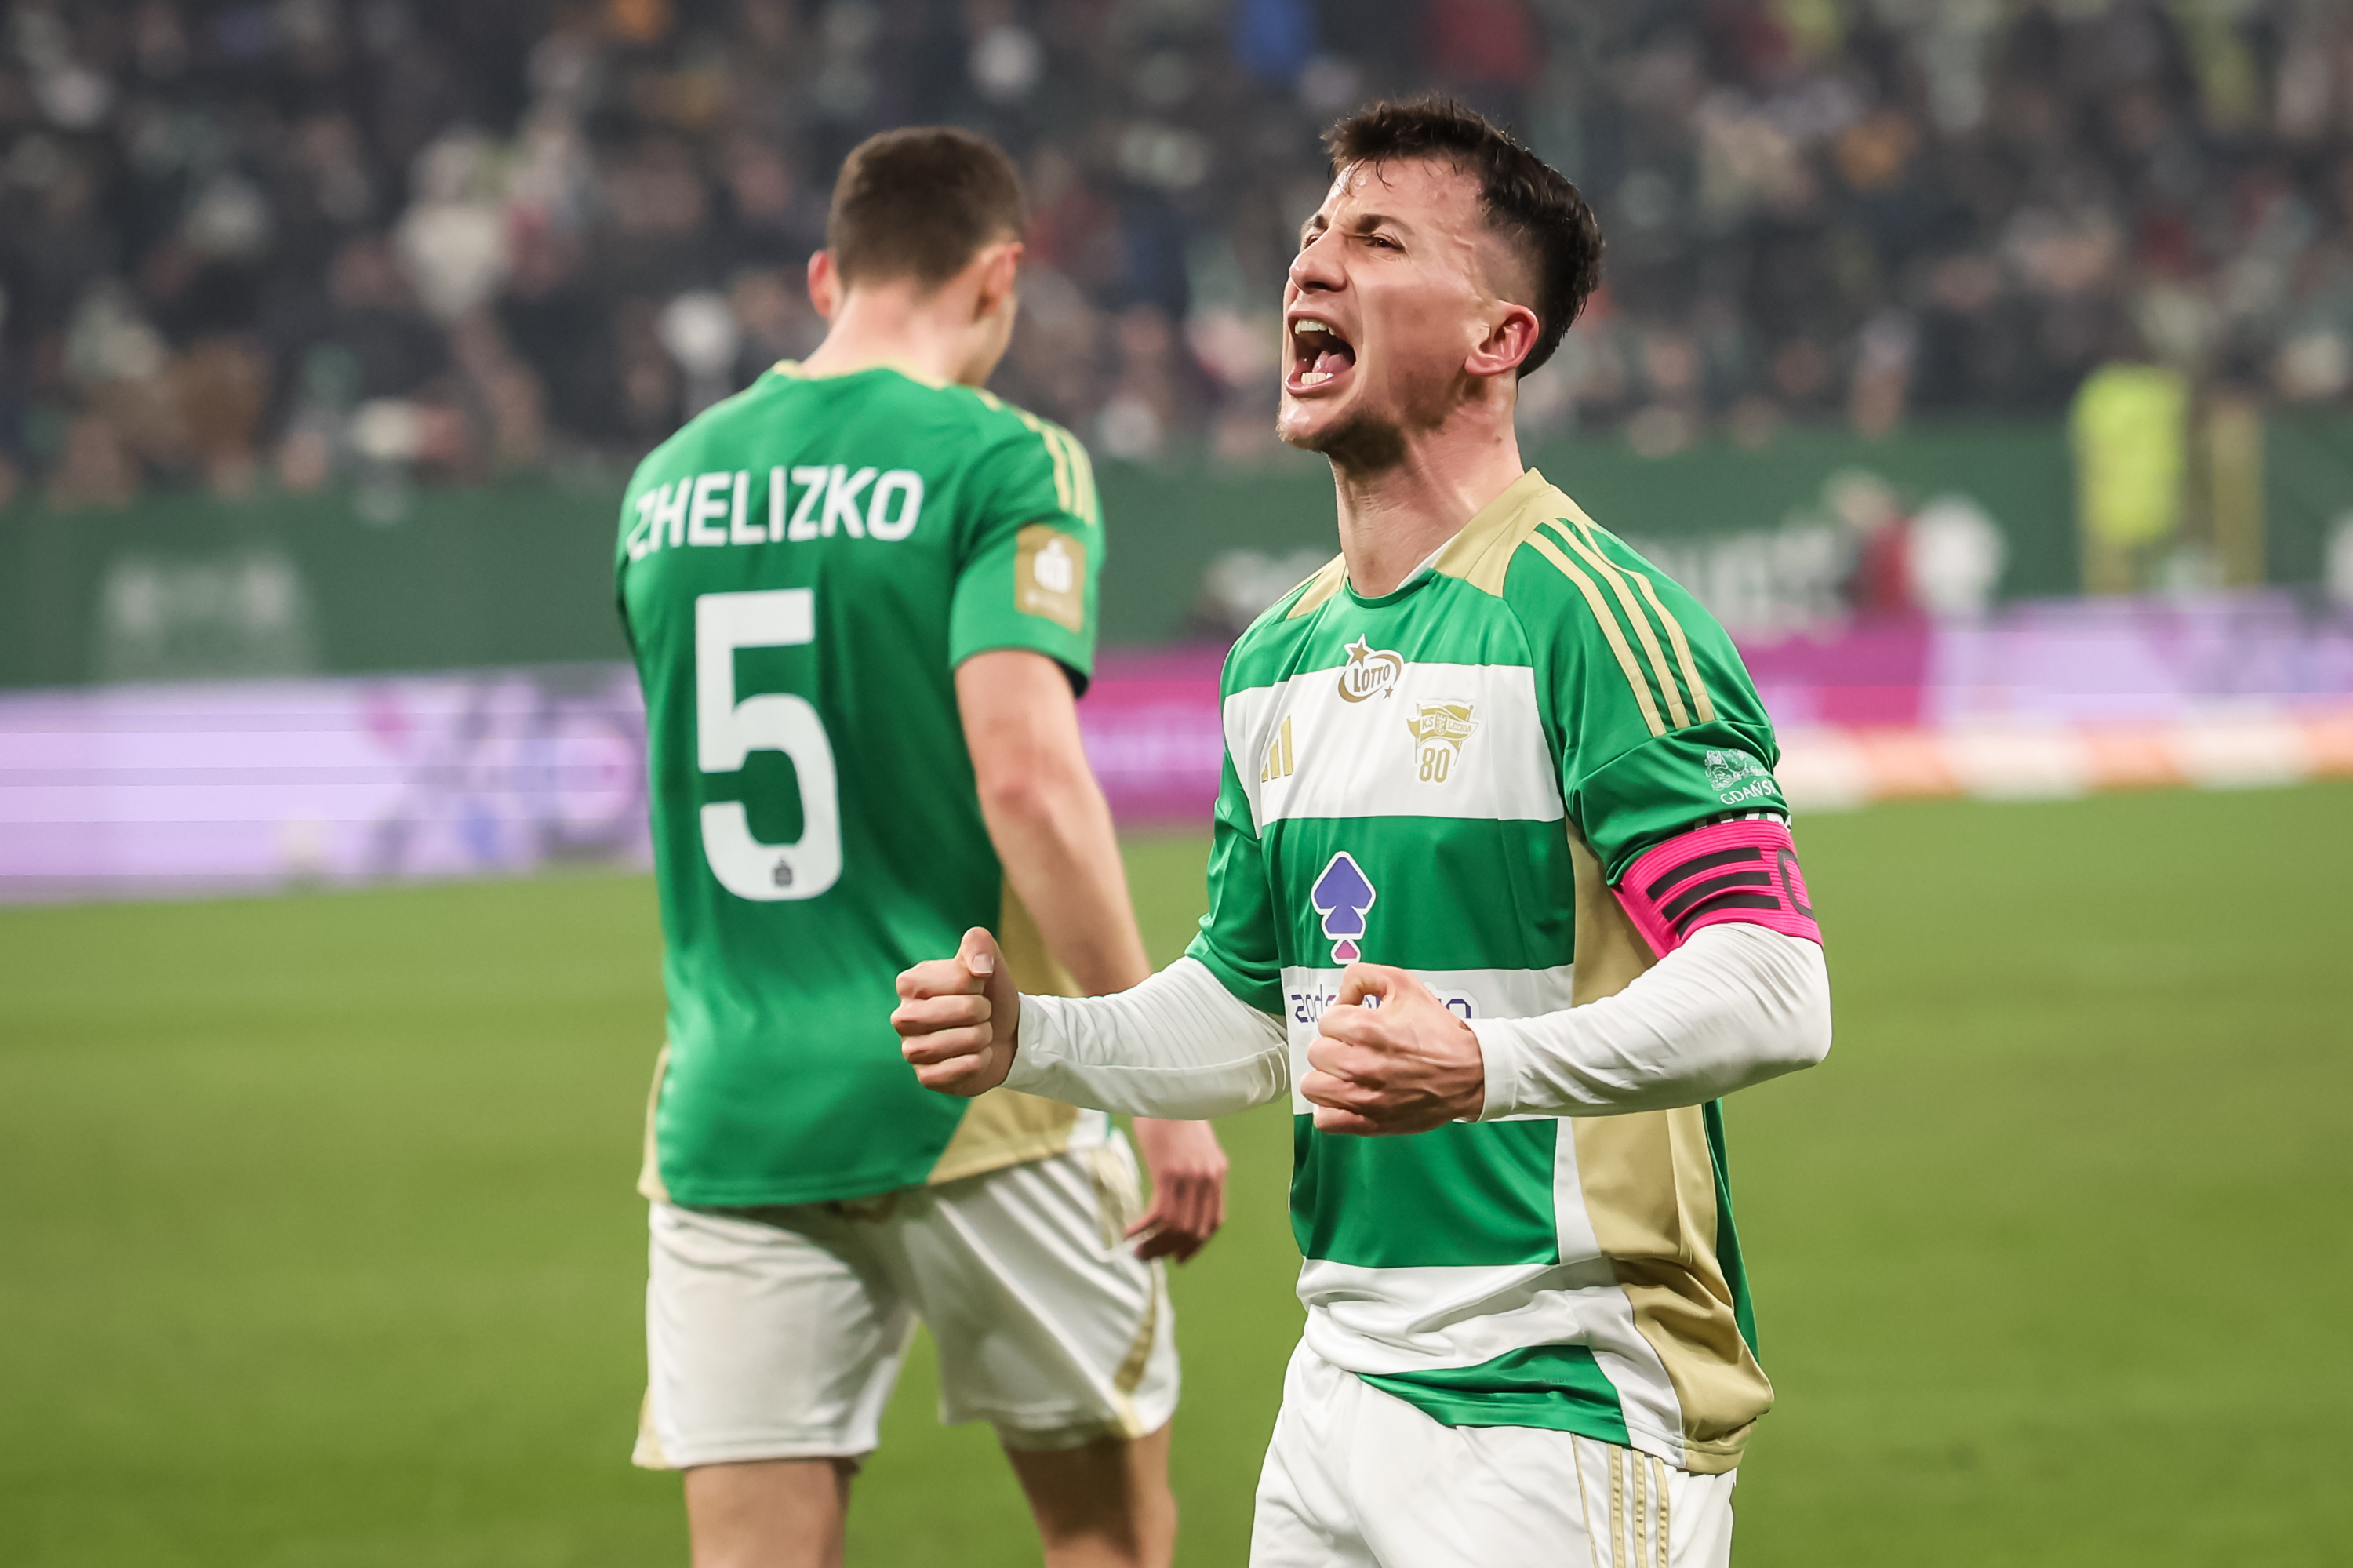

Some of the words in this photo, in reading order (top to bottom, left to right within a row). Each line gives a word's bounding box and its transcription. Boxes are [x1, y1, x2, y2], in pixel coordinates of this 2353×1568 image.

[627, 464, 925, 562] ZHELIZKO
[1353, 664, 1391, 693] LOTTO
[1422, 715, 1435, 730] KS
[1448, 719, 1472, 733] LECHIA
[695, 588, 843, 902] 5
[1419, 747, 1451, 783] 80
